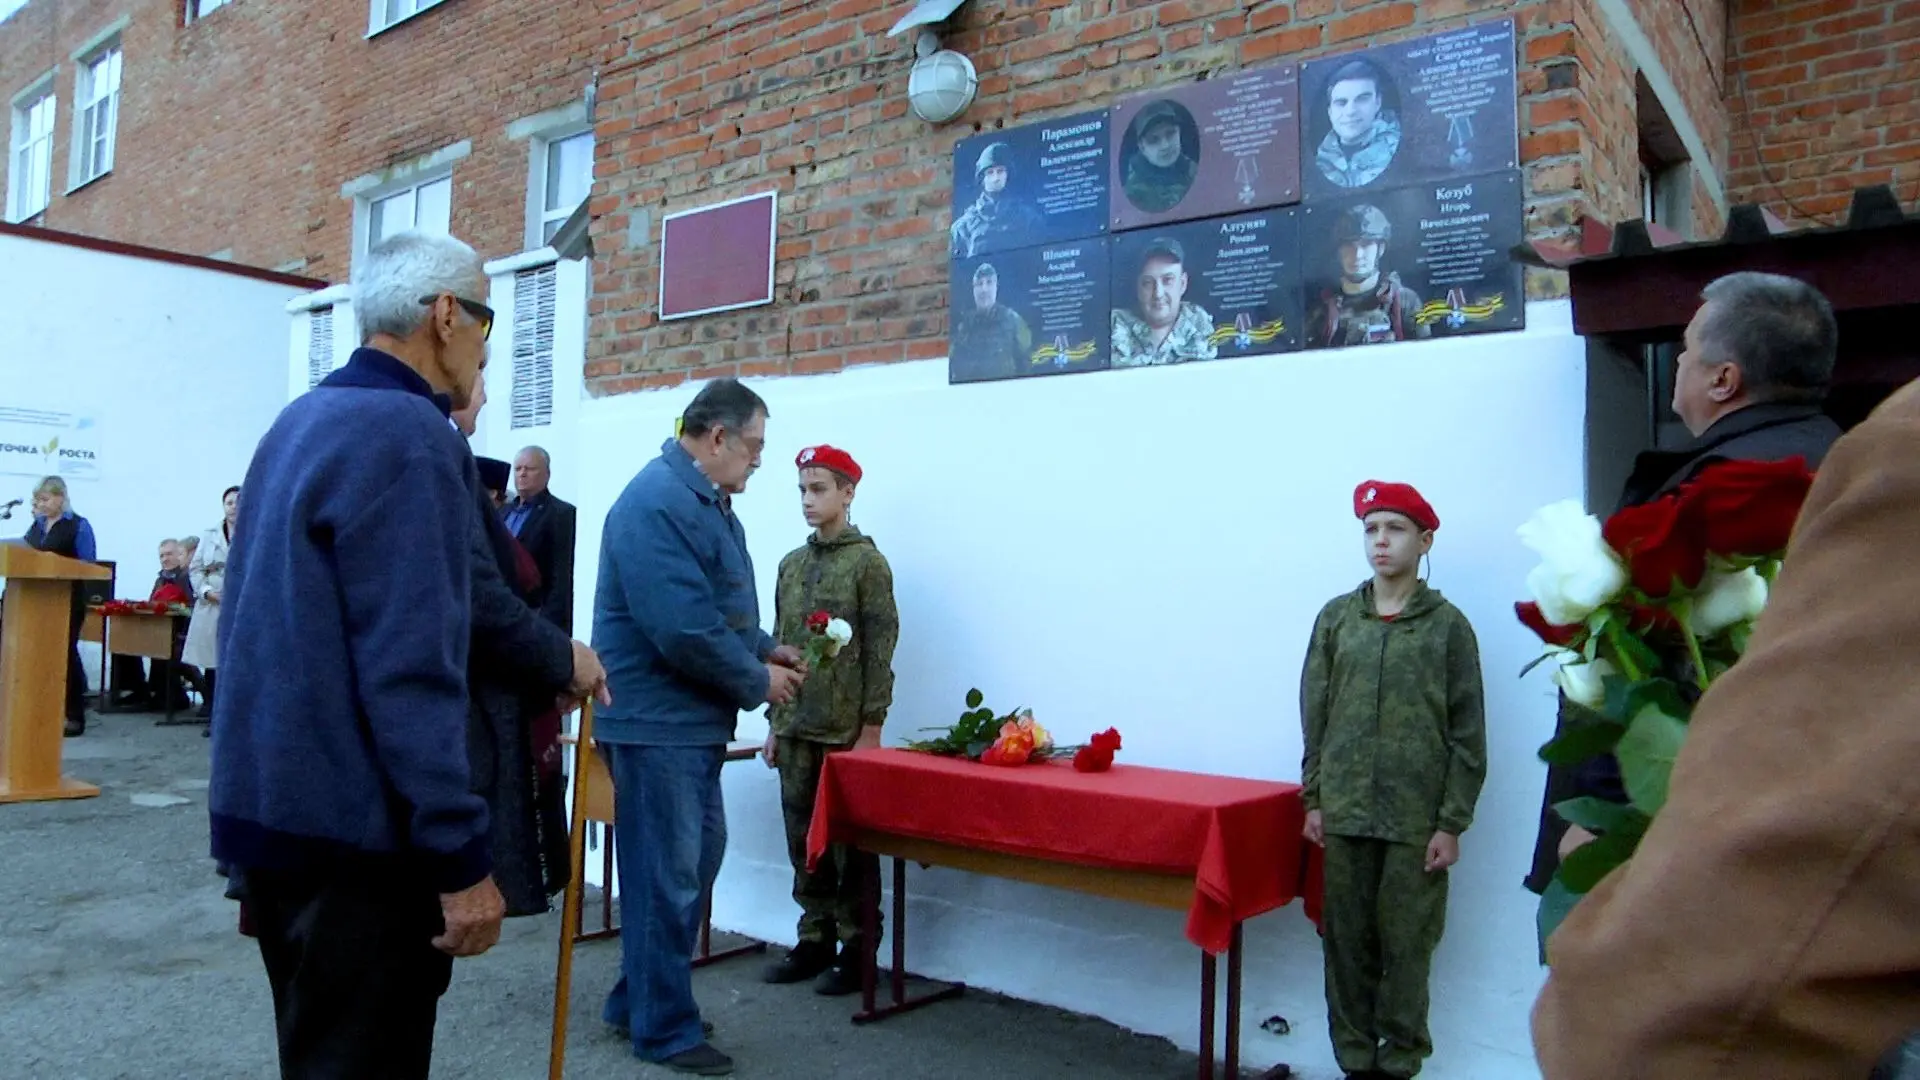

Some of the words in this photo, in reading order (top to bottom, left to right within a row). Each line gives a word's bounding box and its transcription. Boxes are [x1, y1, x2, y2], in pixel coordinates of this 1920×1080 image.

[1041, 121, 1102, 142] Парамонов
[1049, 135, 1096, 152] Александр
[1040, 148, 1103, 168] Валентинович
[1436, 184, 1472, 200] Козуб
[1440, 202, 1472, 215] Игорь
[1420, 213, 1490, 230] Вячеславович
[59, 449, 96, 460] РОСТА
